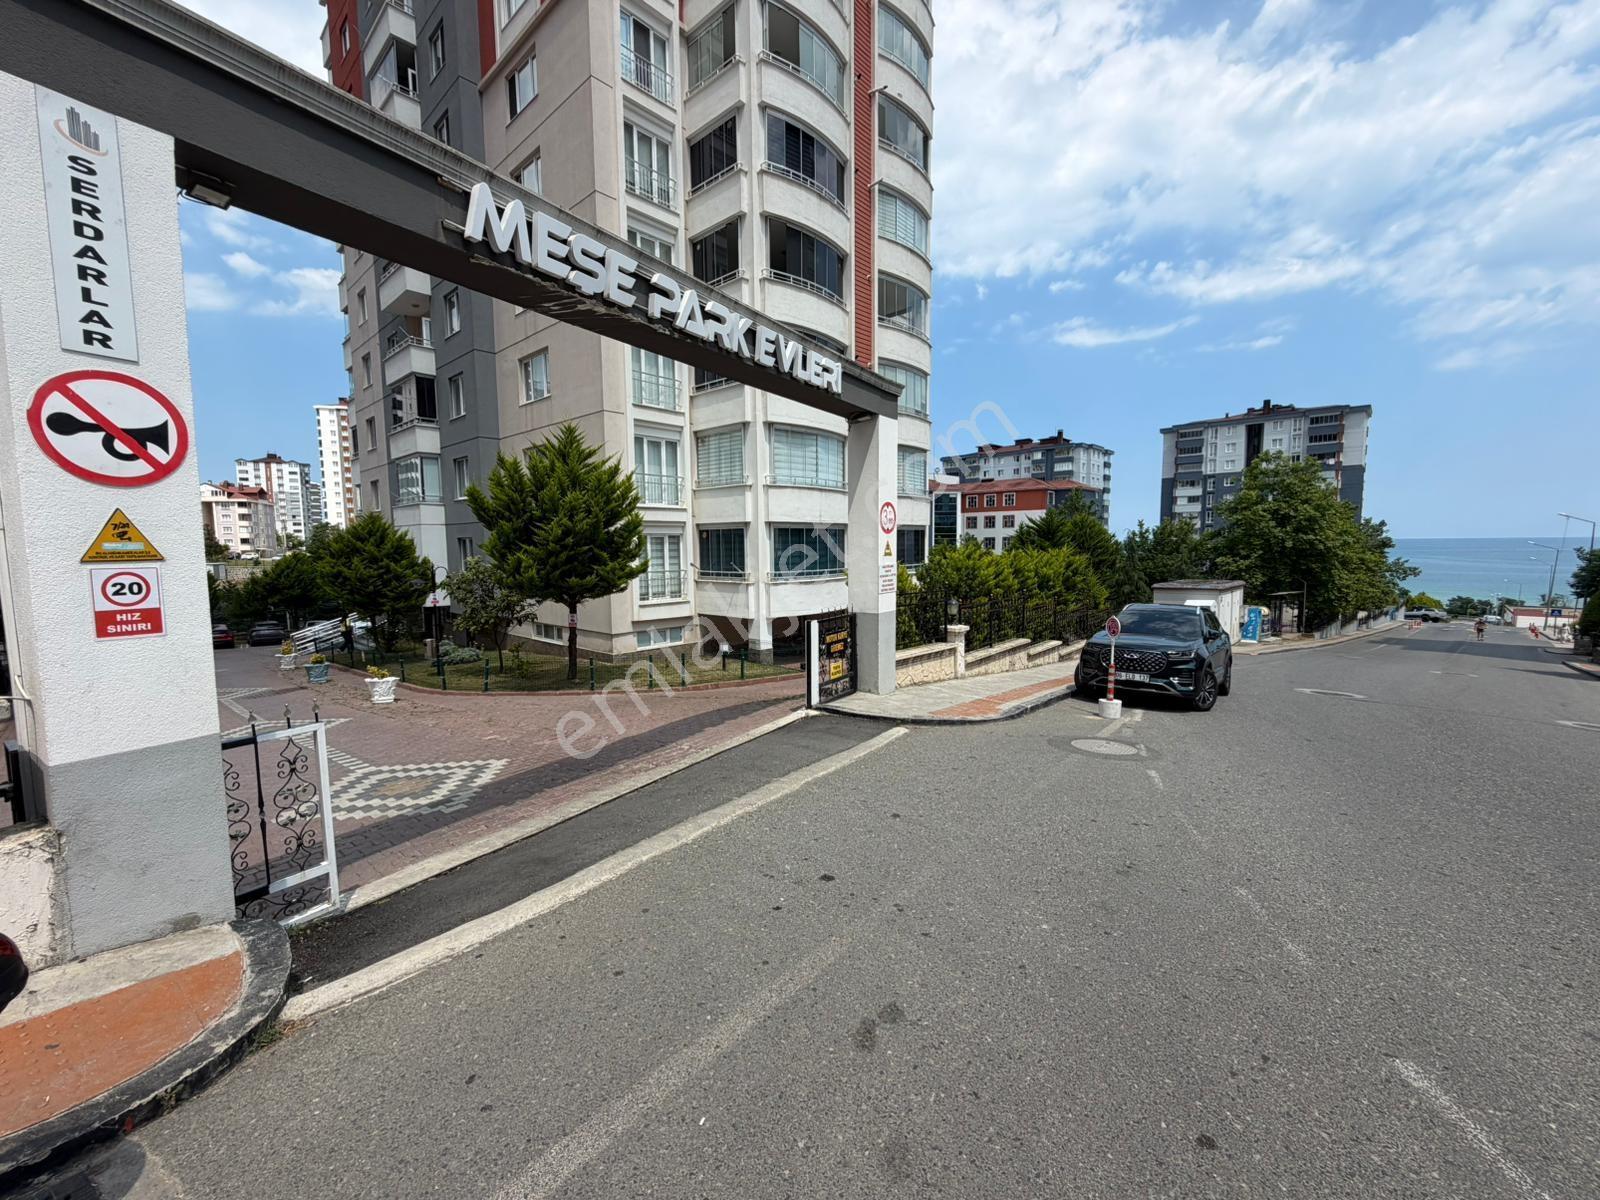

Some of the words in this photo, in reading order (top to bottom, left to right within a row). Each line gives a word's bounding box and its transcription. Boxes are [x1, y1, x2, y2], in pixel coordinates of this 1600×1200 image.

[67, 155, 114, 350] SERDARLAR
[648, 273, 753, 358] PARK
[111, 582, 143, 596] 20
[116, 613, 142, 622] HIZ
[107, 623, 152, 633] SINIRI
